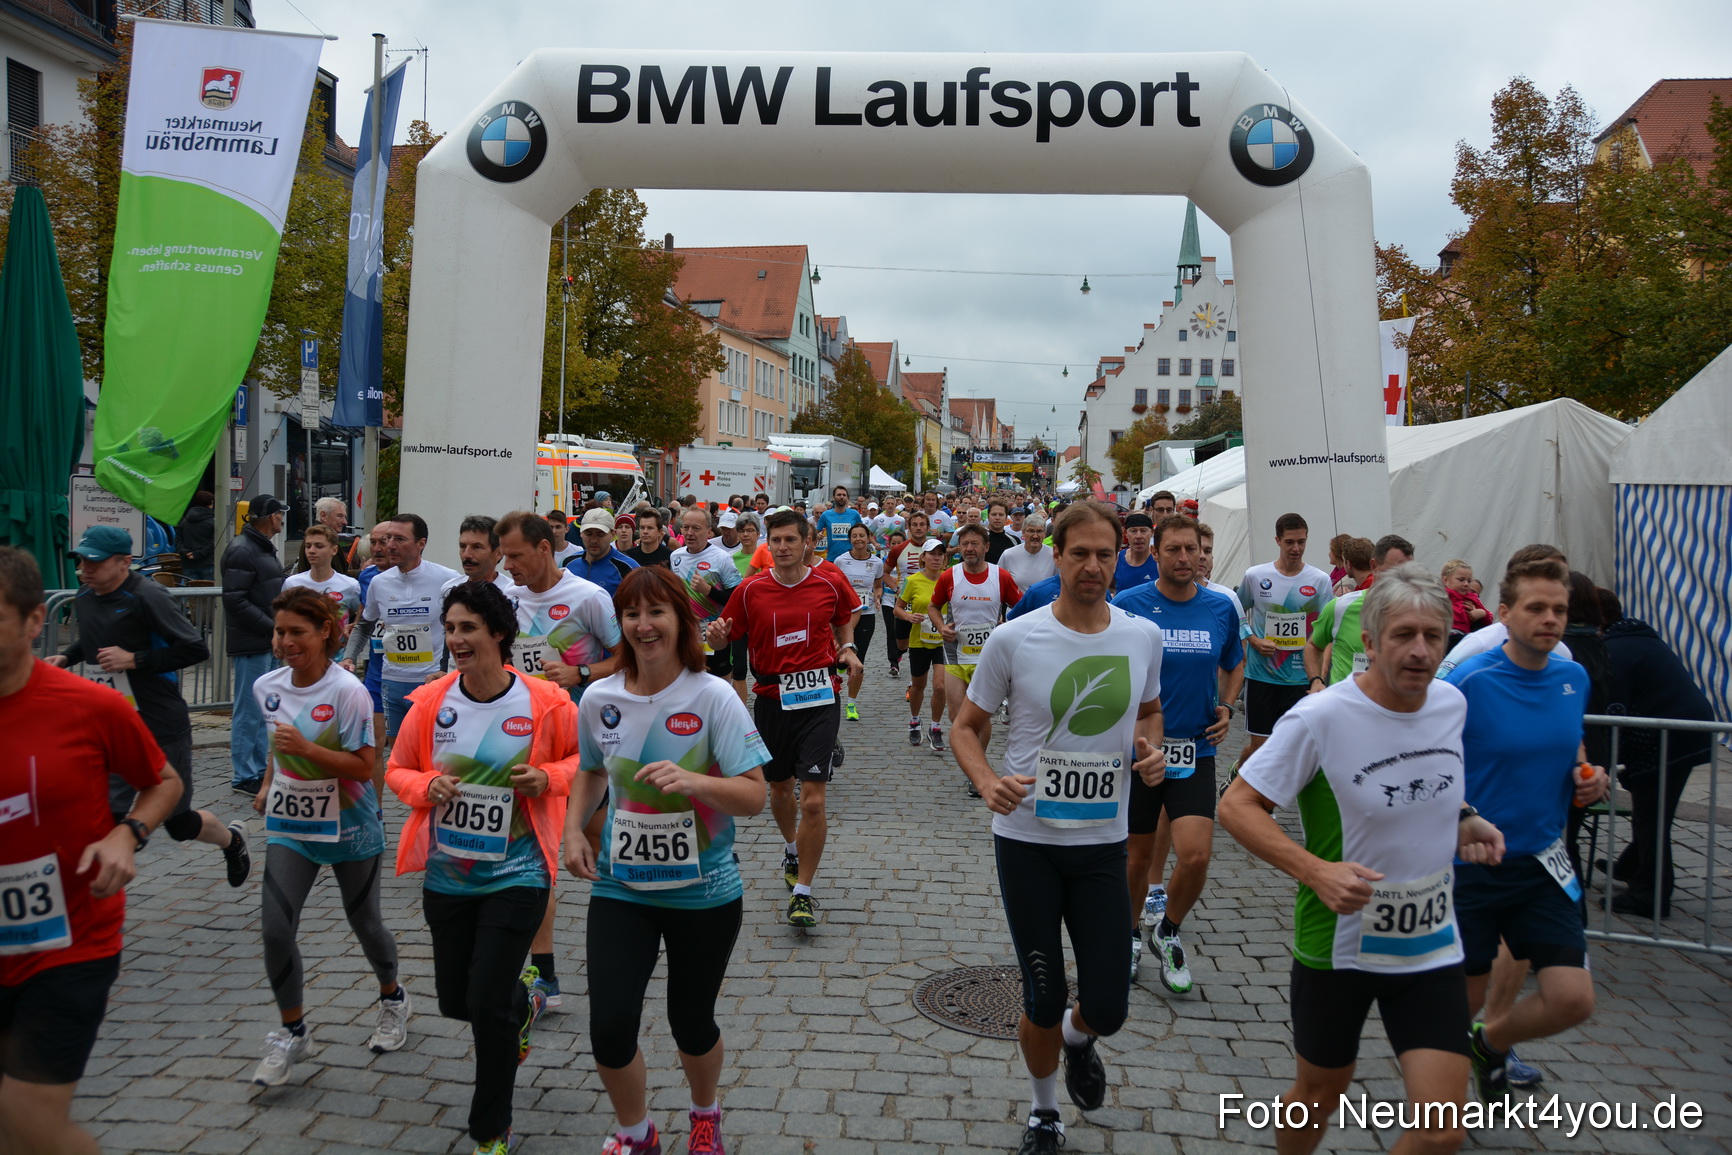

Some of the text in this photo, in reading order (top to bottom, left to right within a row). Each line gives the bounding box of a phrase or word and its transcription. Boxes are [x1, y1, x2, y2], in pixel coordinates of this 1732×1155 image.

[577, 64, 1201, 143] BMW Laufsport
[478, 102, 541, 129] BMW
[1237, 105, 1305, 132] BMW
[304, 339, 315, 363] P
[237, 390, 245, 420] P
[262, 439, 269, 453] 3
[403, 443, 512, 459] www.bmw-laufsport.de
[1268, 452, 1386, 468] www.bmw-laufsport.de
[83, 504, 134, 514] Kreuzung über
[97, 515, 120, 523] Untere
[907, 551, 919, 575] MIT
[1274, 622, 1299, 637] 126
[396, 634, 417, 651] 80
[523, 641, 548, 649] Neumarkt
[1273, 638, 1298, 646] Christian
[396, 654, 420, 662] Helmut
[522, 650, 545, 673] 55
[784, 669, 827, 691] 2094
[794, 692, 821, 702] Thomas
[506, 721, 532, 732] Hervis
[670, 718, 698, 730] Hervis
[435, 731, 457, 739] PARTL
[1039, 756, 1110, 768] PARTL Neumarkt
[1164, 770, 1181, 778] nter
[273, 779, 324, 793] PARTL Neumarkt
[1044, 769, 1115, 799] 3008
[460, 790, 499, 801] Neumarkt
[272, 791, 331, 818] 2637
[441, 800, 504, 833] 2059
[614, 817, 679, 830] PARTL Neumarkt
[280, 821, 322, 833] Manuela
[449, 833, 485, 850] Claudia
[618, 831, 690, 862] 2456
[627, 867, 682, 881] Sieglinde
[1373, 880, 1443, 900] ARTL Neumarkt
[2, 881, 53, 921] 03
[1373, 890, 1447, 934] 3043
